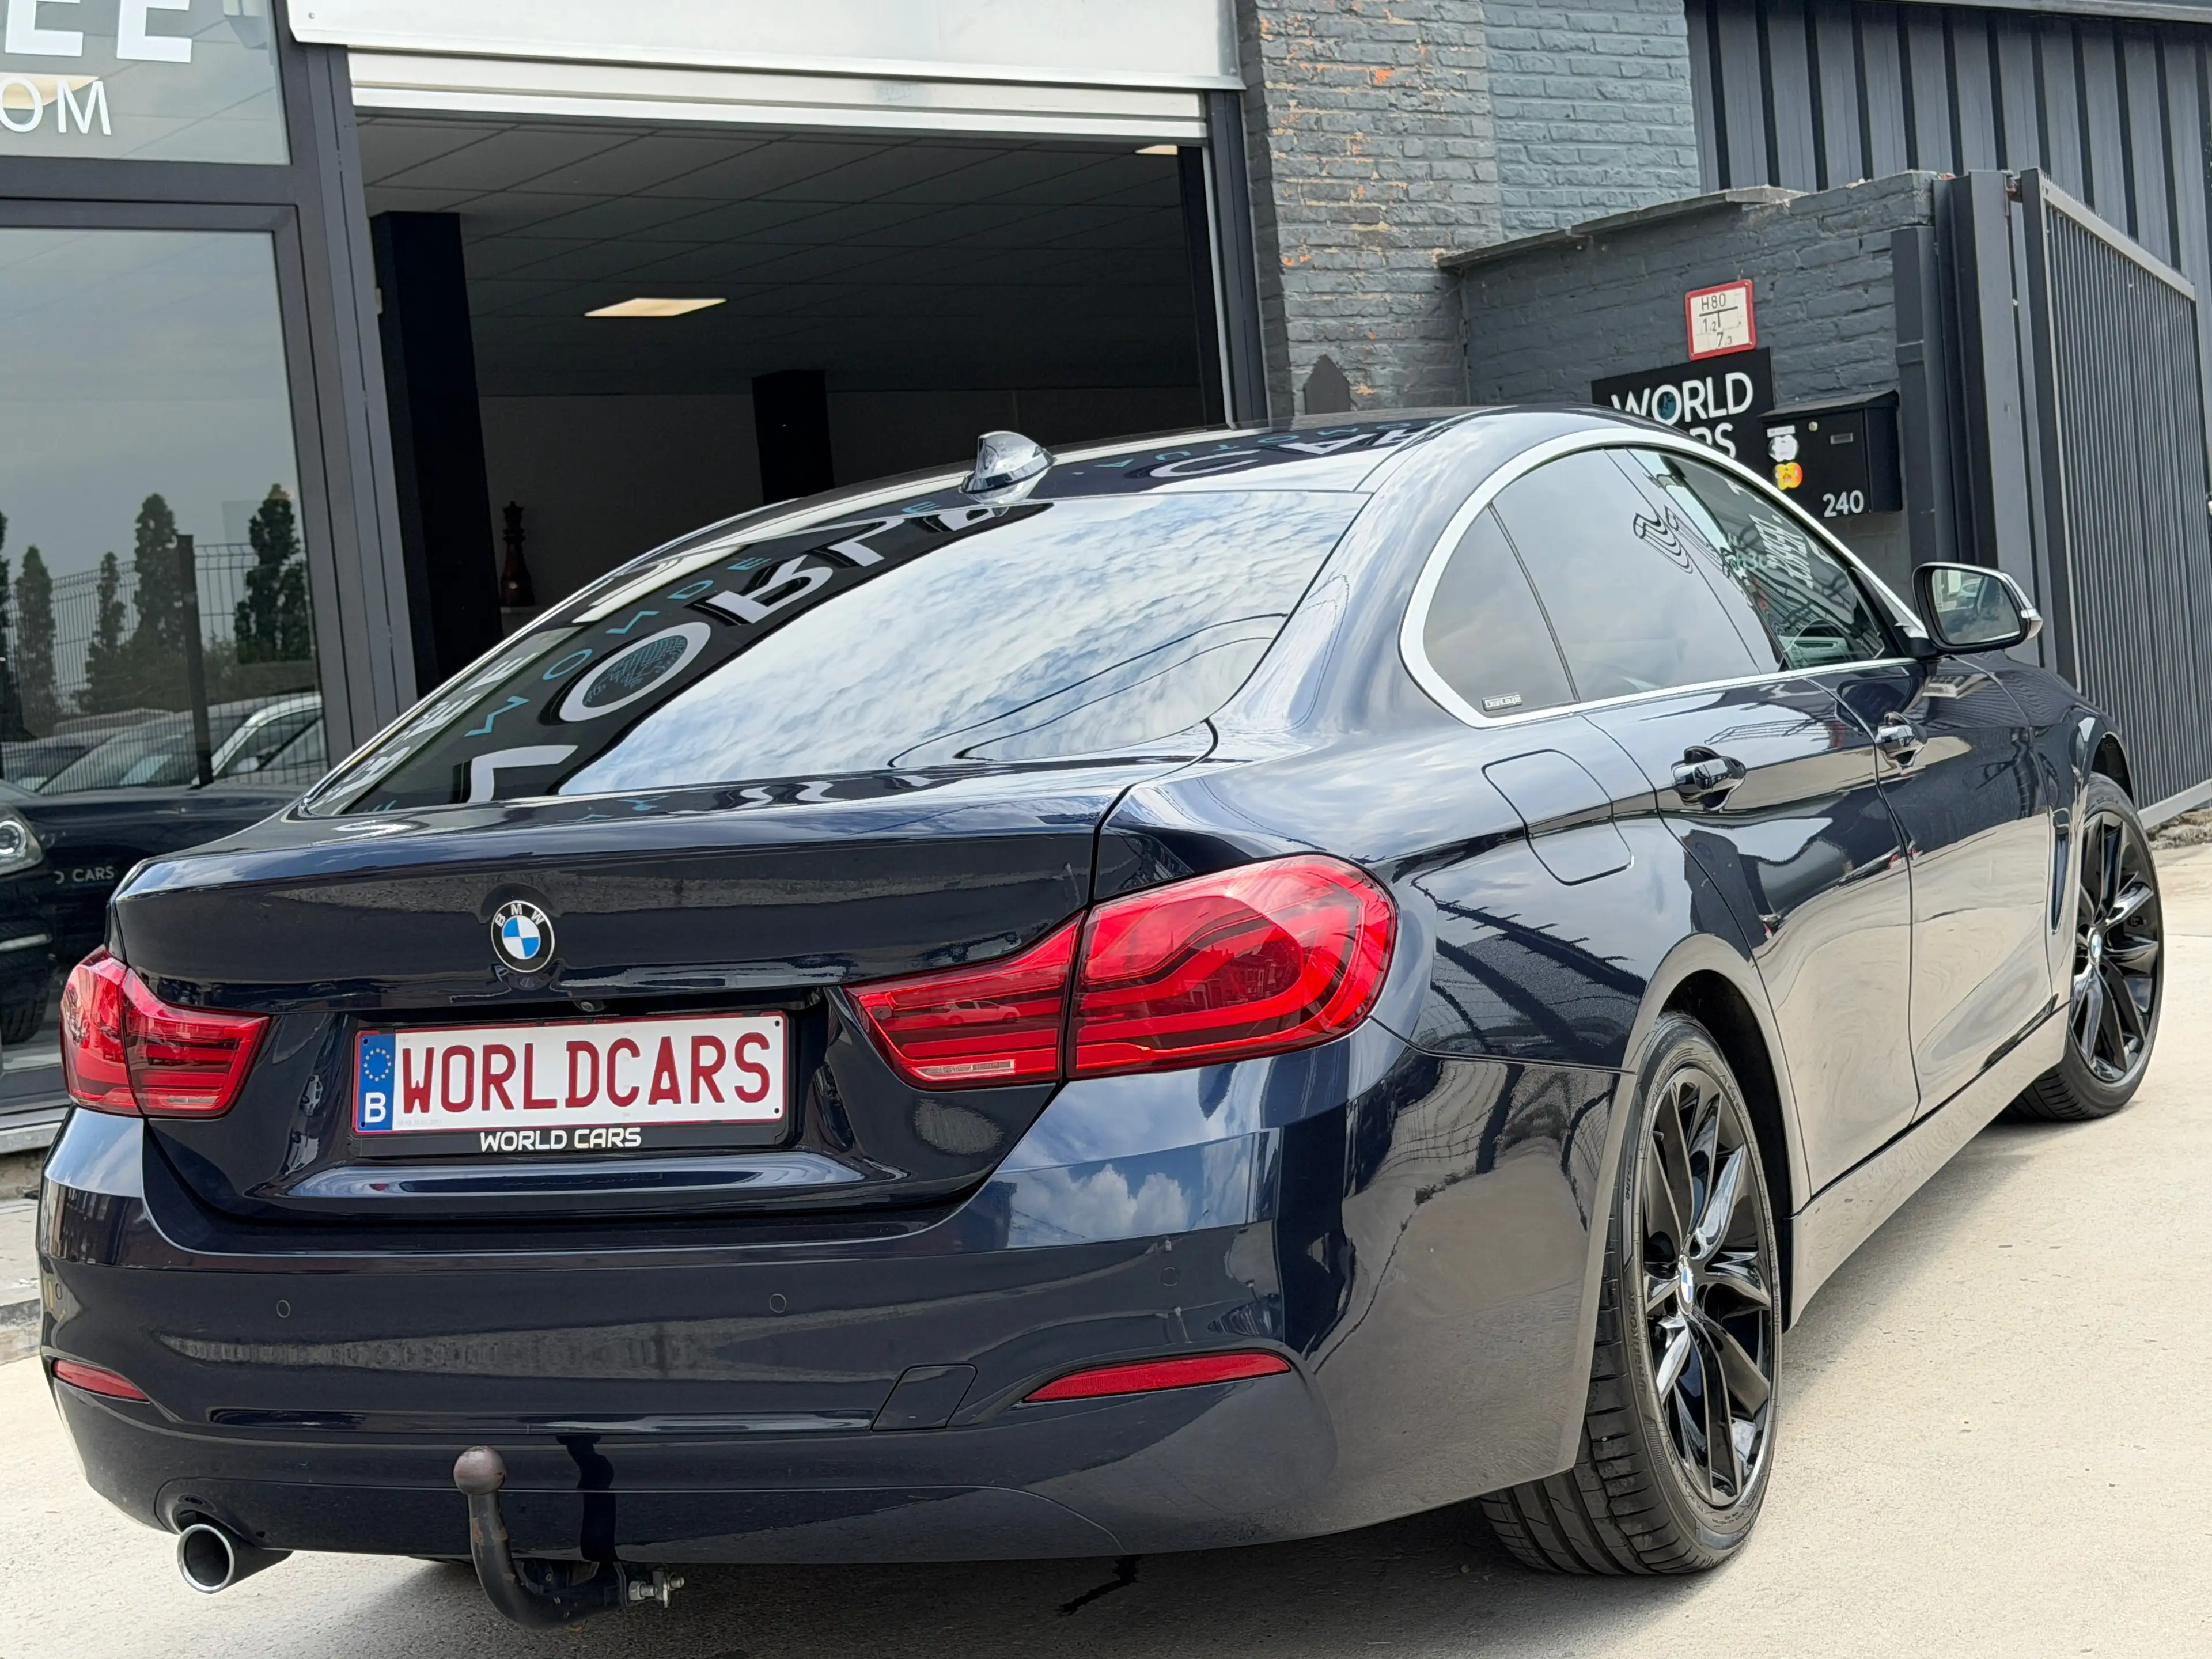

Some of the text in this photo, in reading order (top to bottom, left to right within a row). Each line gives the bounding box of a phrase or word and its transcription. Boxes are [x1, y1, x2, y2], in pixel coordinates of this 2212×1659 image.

[1701, 293, 1726, 311] H80
[1611, 372, 1753, 426] WORLD
[1822, 490, 1865, 518] 240
[73, 865, 115, 882] CARS
[495, 903, 544, 927] BMW
[402, 1032, 771, 1115] WORLDCARS
[365, 1092, 386, 1123] B
[480, 1127, 642, 1152] WORLD CARS
